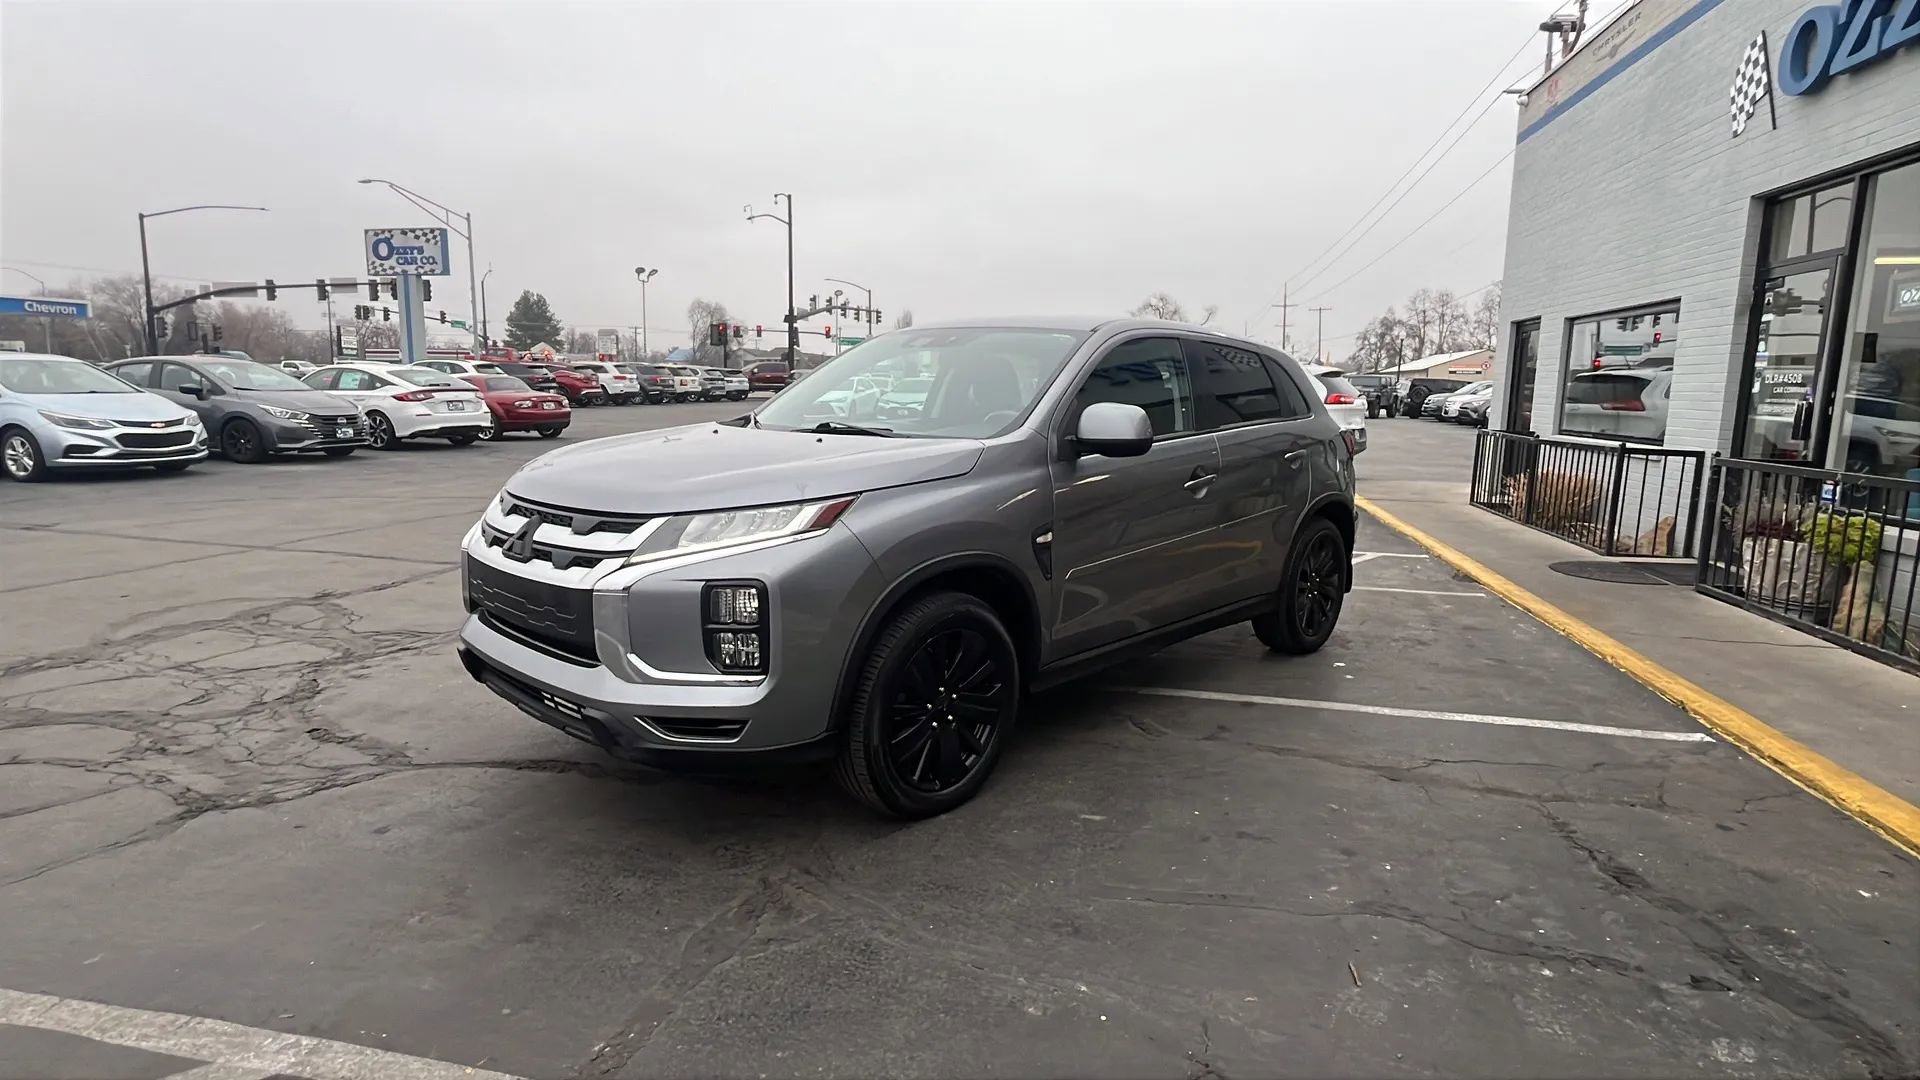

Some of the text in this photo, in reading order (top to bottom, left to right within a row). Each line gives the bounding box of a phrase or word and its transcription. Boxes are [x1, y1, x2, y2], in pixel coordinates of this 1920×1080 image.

[1592, 11, 1642, 57] CHRYSLER
[396, 255, 438, 265] CAR CO.
[24, 301, 77, 315] Chevron
